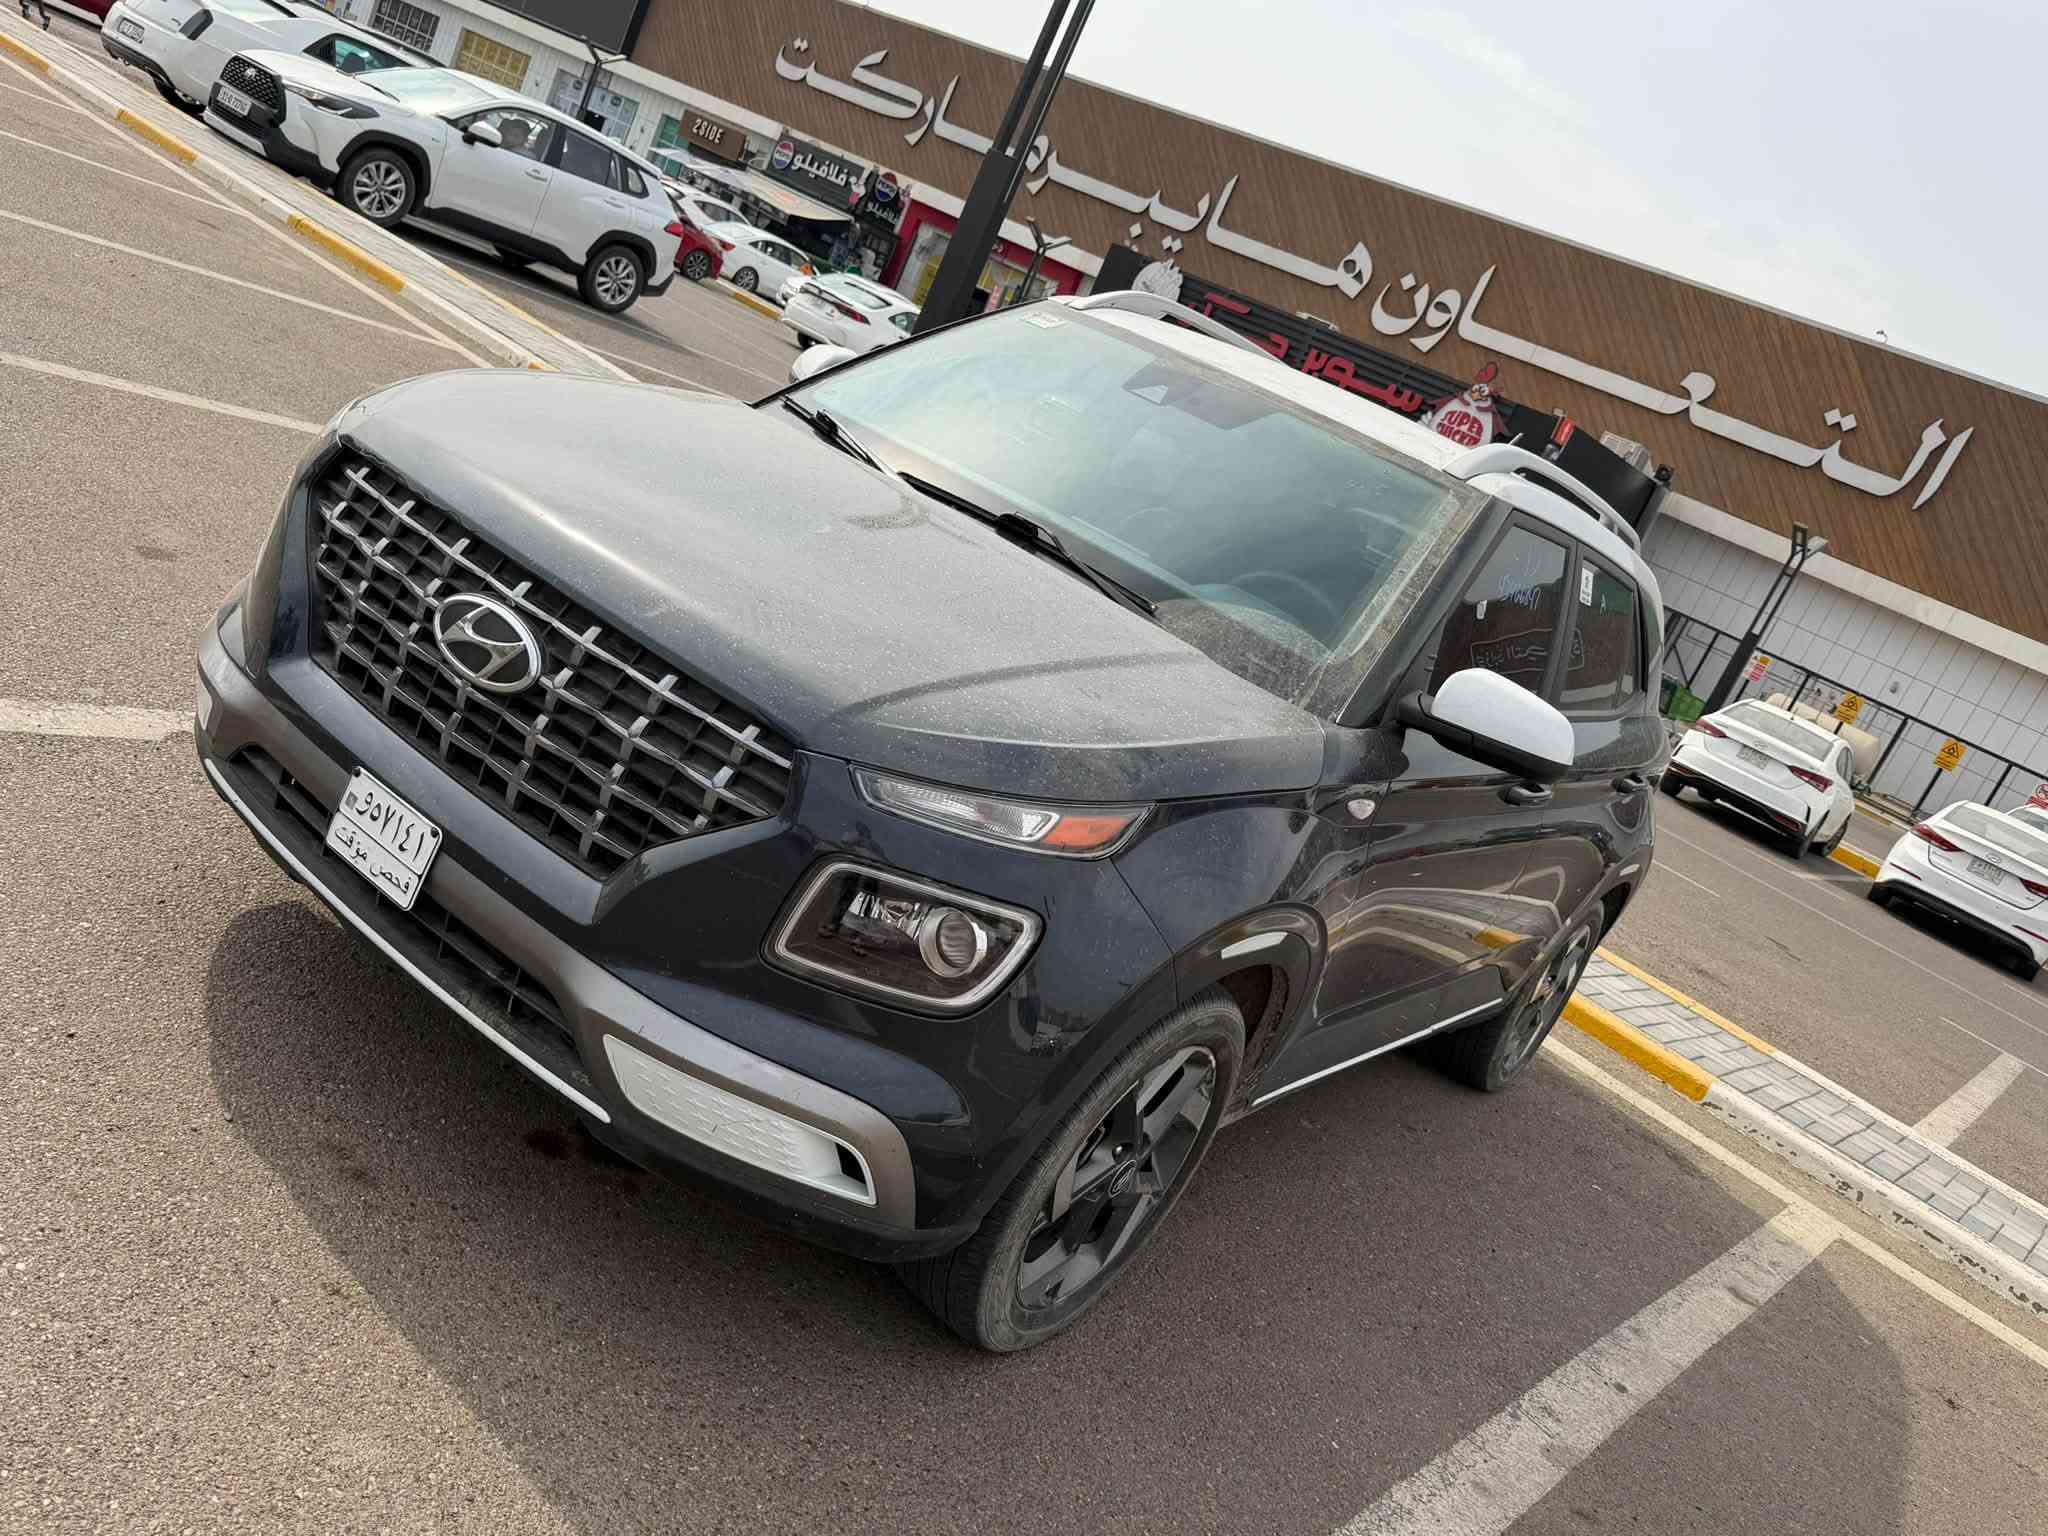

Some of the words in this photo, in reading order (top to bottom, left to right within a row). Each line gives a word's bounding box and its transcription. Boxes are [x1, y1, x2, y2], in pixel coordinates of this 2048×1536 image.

[692, 118, 725, 145] 2SIDE
[775, 36, 1051, 175] ماركت
[791, 153, 848, 187] فلافيلو
[1026, 149, 1374, 300] هايبر
[1371, 263, 1975, 511] التعاون
[355, 792, 425, 862] ٩٥٧١٤١
[369, 863, 412, 895] فحص
